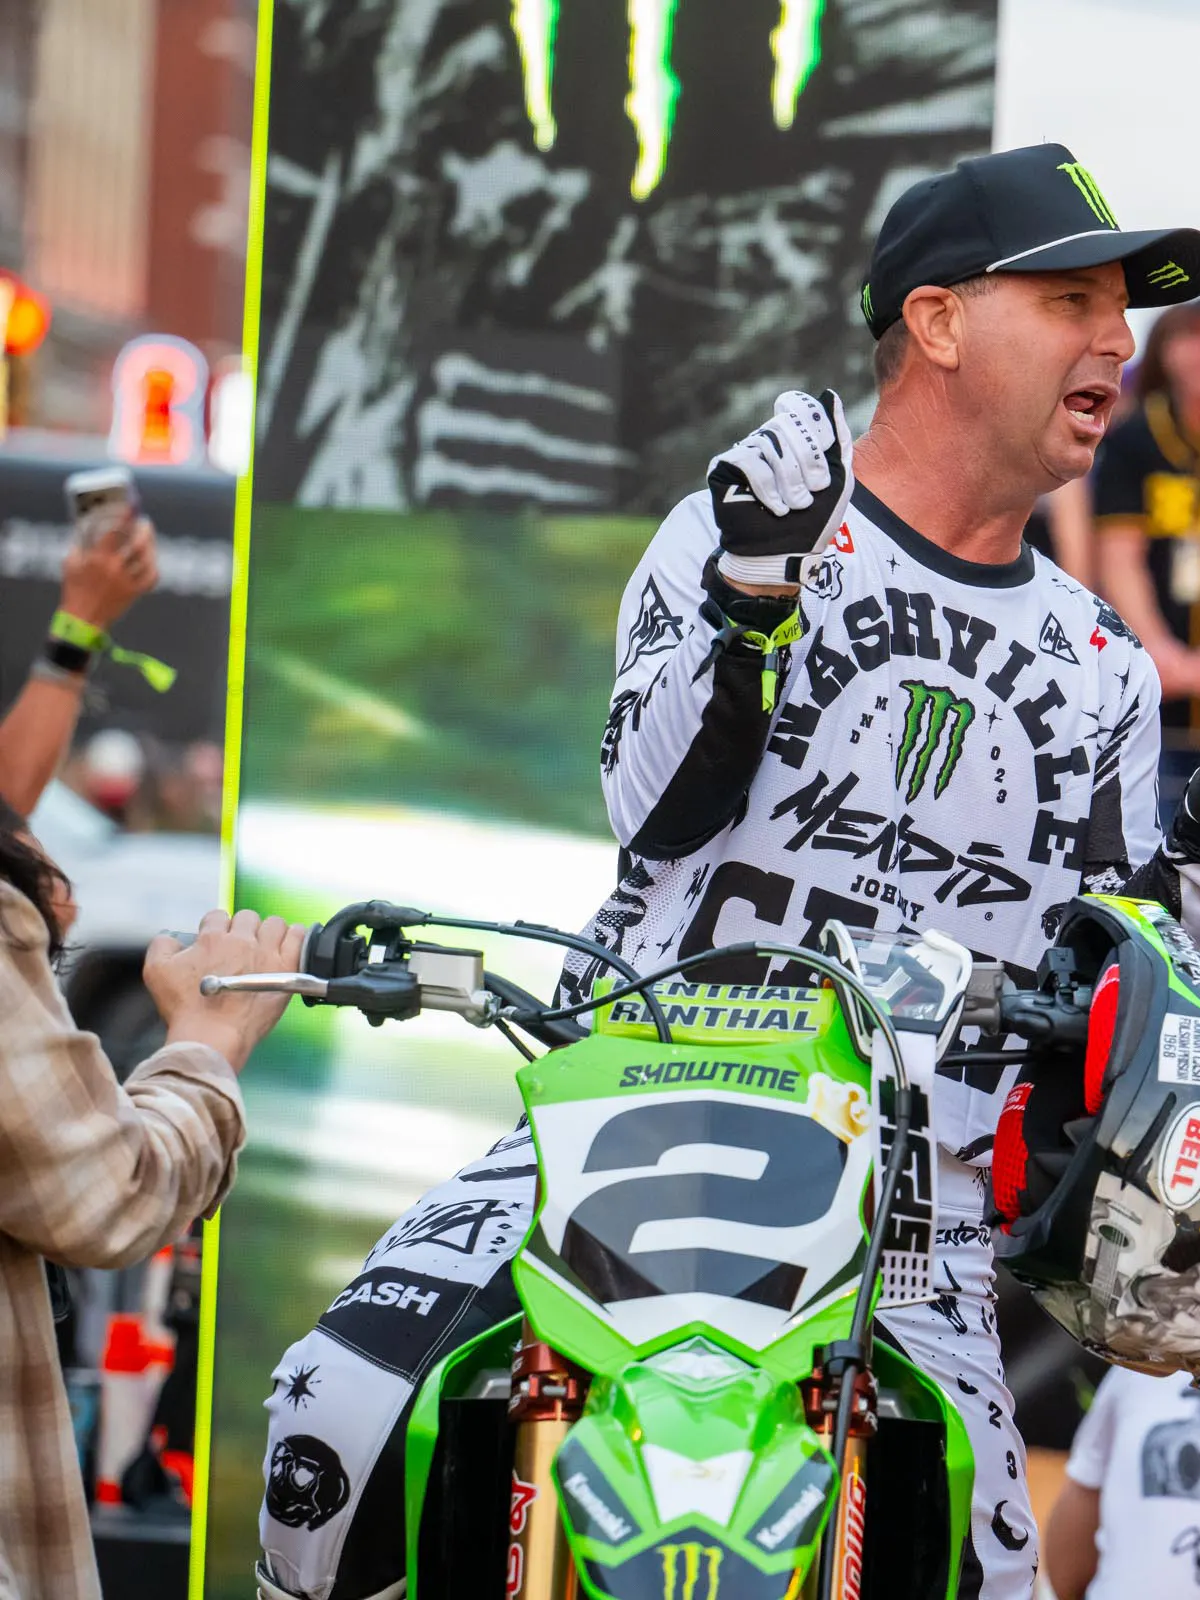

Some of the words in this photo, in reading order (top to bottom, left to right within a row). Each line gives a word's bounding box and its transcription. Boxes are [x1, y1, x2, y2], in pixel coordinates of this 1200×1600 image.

[766, 586, 1092, 872] NASHVILLE
[1163, 1033, 1177, 1059] 1968
[619, 1061, 801, 1093] SHOWTIME
[560, 1099, 850, 1314] 2
[326, 1281, 441, 1318] CASH
